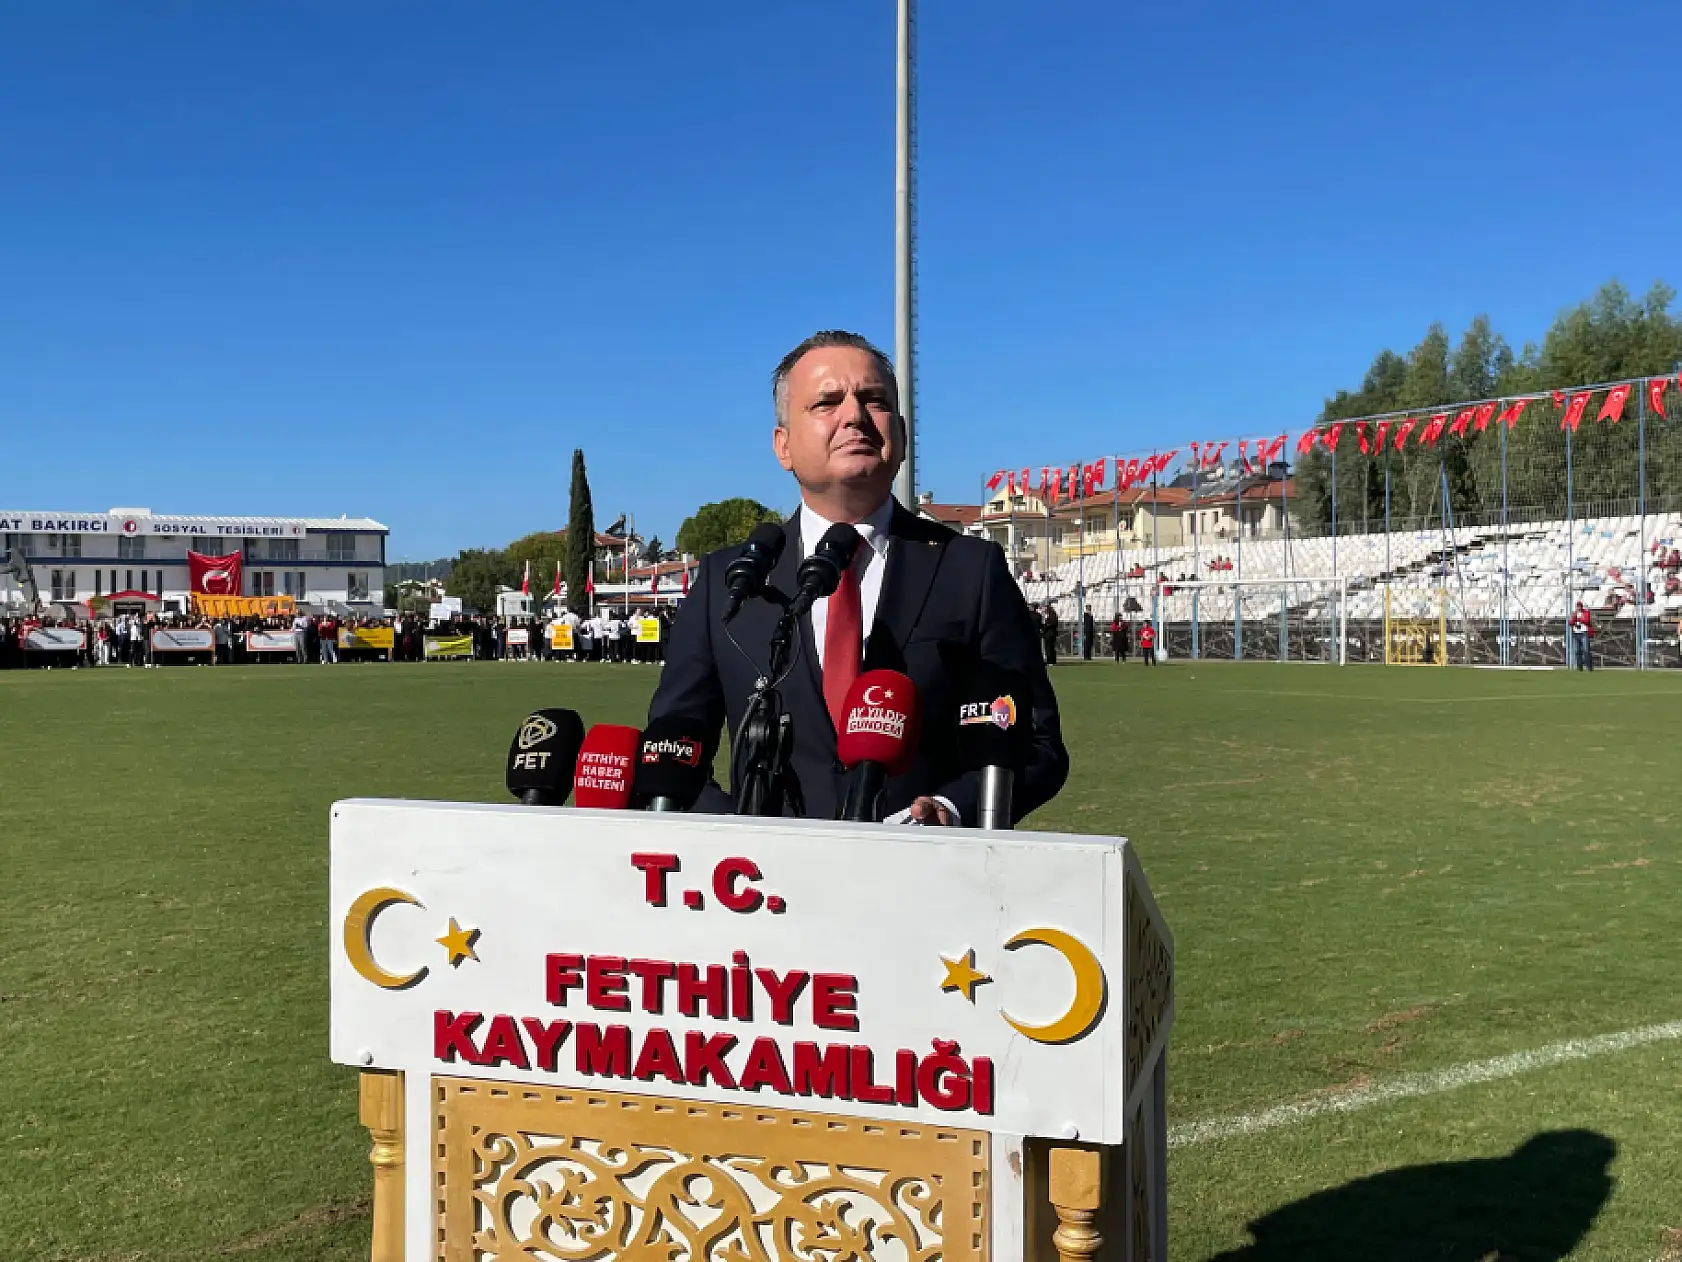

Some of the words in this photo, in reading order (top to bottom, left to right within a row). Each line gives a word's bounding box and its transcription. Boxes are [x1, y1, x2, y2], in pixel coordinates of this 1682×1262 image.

[32, 519, 108, 532] BAKIRCI
[153, 523, 207, 535] SOSYAL
[960, 702, 988, 718] FRT
[643, 739, 694, 757] Fethiye
[513, 752, 551, 770] FET
[581, 752, 629, 767] FETHİYE
[582, 766, 623, 779] HABER
[631, 851, 786, 914] T.C.
[545, 950, 859, 1032] FETHİYE
[433, 1009, 995, 1116] KAYMAKAMLIĞI
